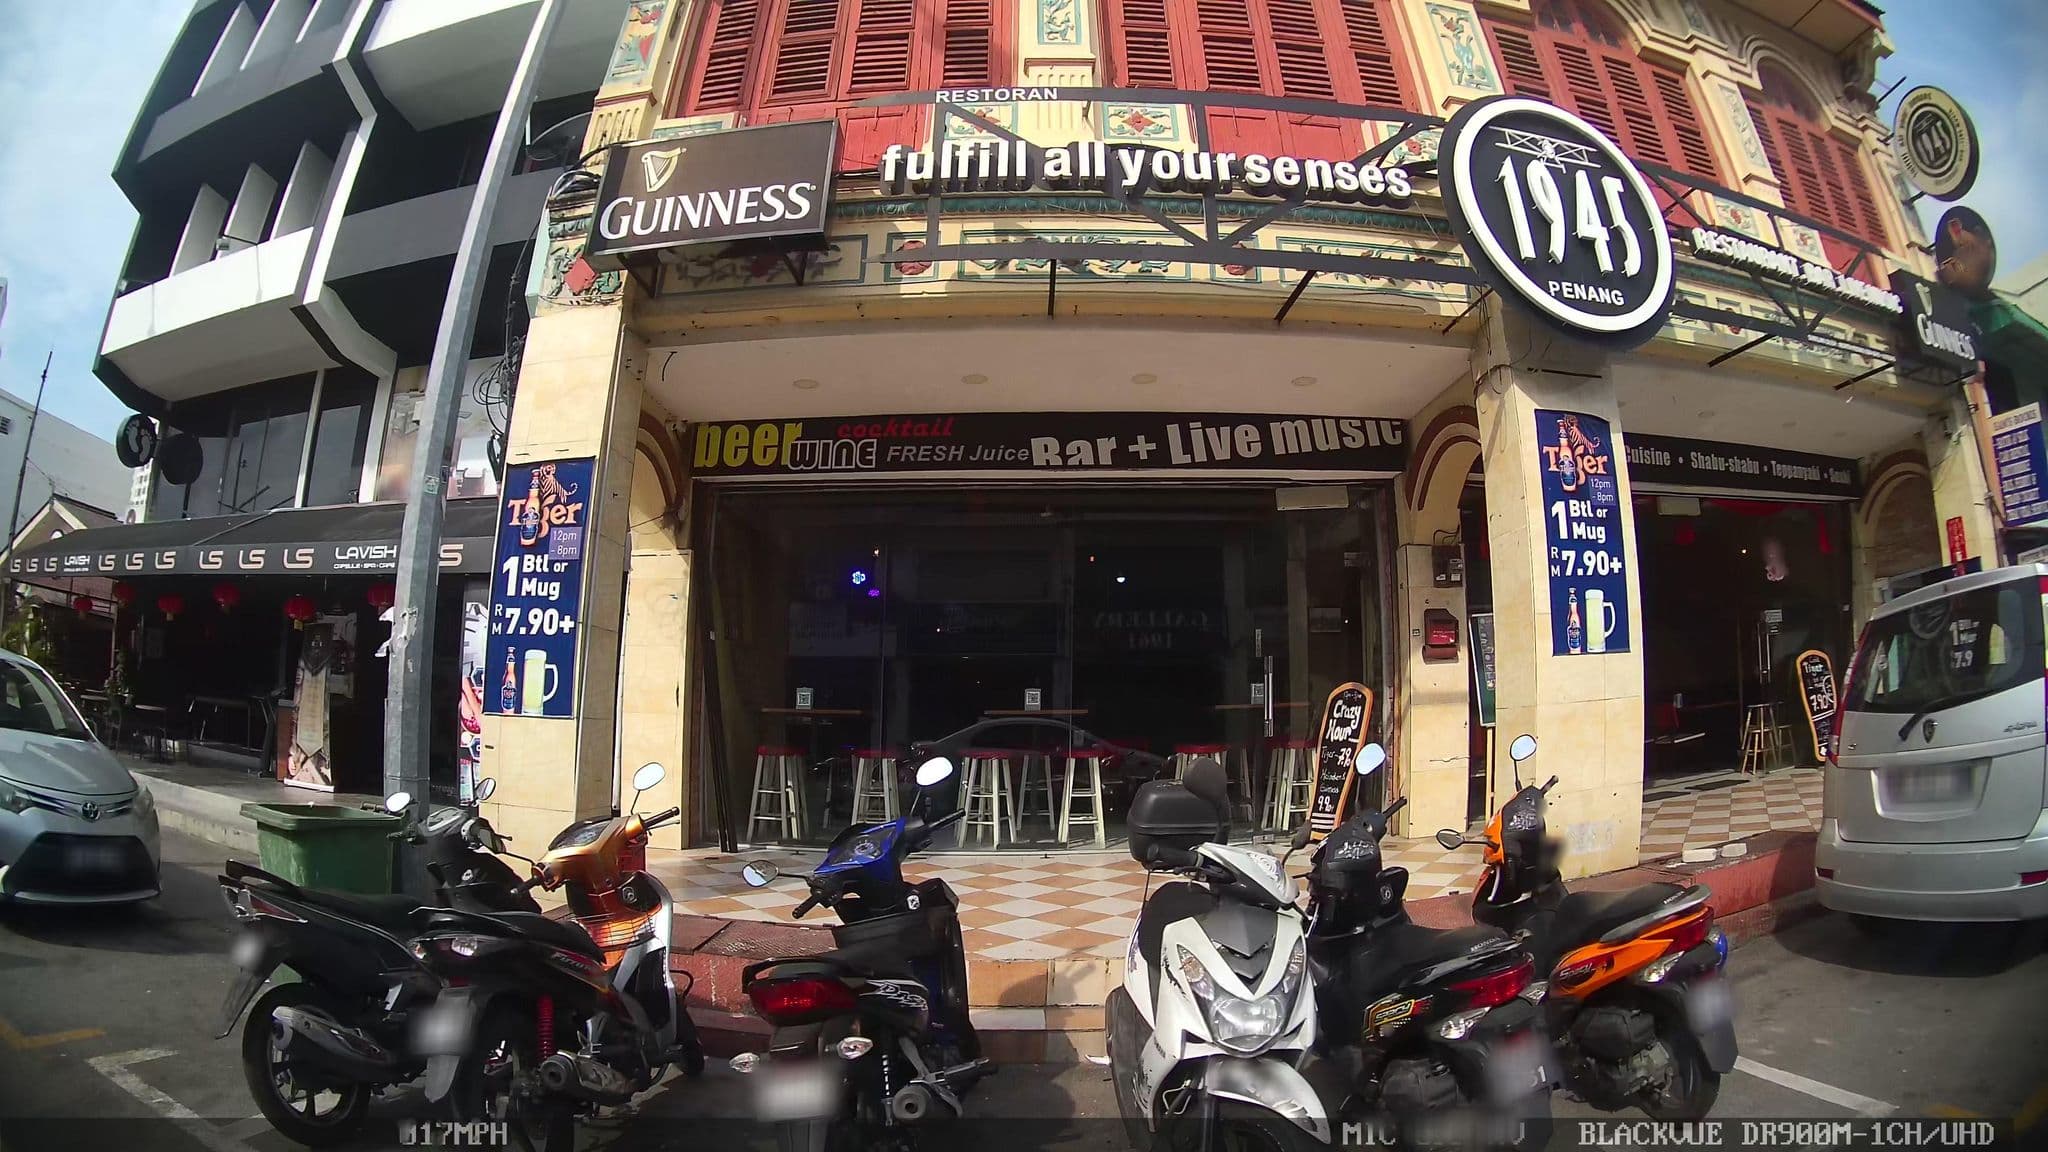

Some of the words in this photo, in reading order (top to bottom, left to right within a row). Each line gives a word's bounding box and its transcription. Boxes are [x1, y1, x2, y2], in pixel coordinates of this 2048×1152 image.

[936, 87, 1059, 104] RESTORAN
[881, 139, 1027, 183] fulfill
[1043, 140, 1106, 180] all
[1117, 146, 1237, 187] your
[1244, 153, 1414, 198] senses
[600, 183, 814, 241] GUINNESS
[1495, 154, 1643, 278] 1945
[1547, 279, 1625, 306] PENANG
[837, 417, 954, 439] cocktail
[1166, 421, 1262, 465] Live
[1269, 418, 1403, 456] music
[693, 421, 803, 468] beer
[887, 445, 965, 462] FRESH
[969, 444, 1029, 462] Juice
[1543, 445, 1609, 485] Tger
[1691, 451, 1760, 475] Shabu-shabu
[1591, 478, 1611, 489] 12pm
[508, 495, 584, 538] Tger
[1551, 501, 1569, 540] 1
[1570, 499, 1593, 518] Btl
[1596, 508, 1608, 518] or
[553, 530, 577, 543] 12pm
[1572, 522, 1606, 544] Mug
[334, 544, 398, 560] LAVISH
[438, 543, 464, 567] S
[1562, 550, 1623, 577] 7.90+
[502, 556, 520, 597] 1
[522, 554, 550, 573] Btl
[553, 561, 568, 573] or
[521, 577, 561, 601] Mug
[505, 607, 575, 636] 7.90+
[1333, 699, 1362, 730] Crazy
